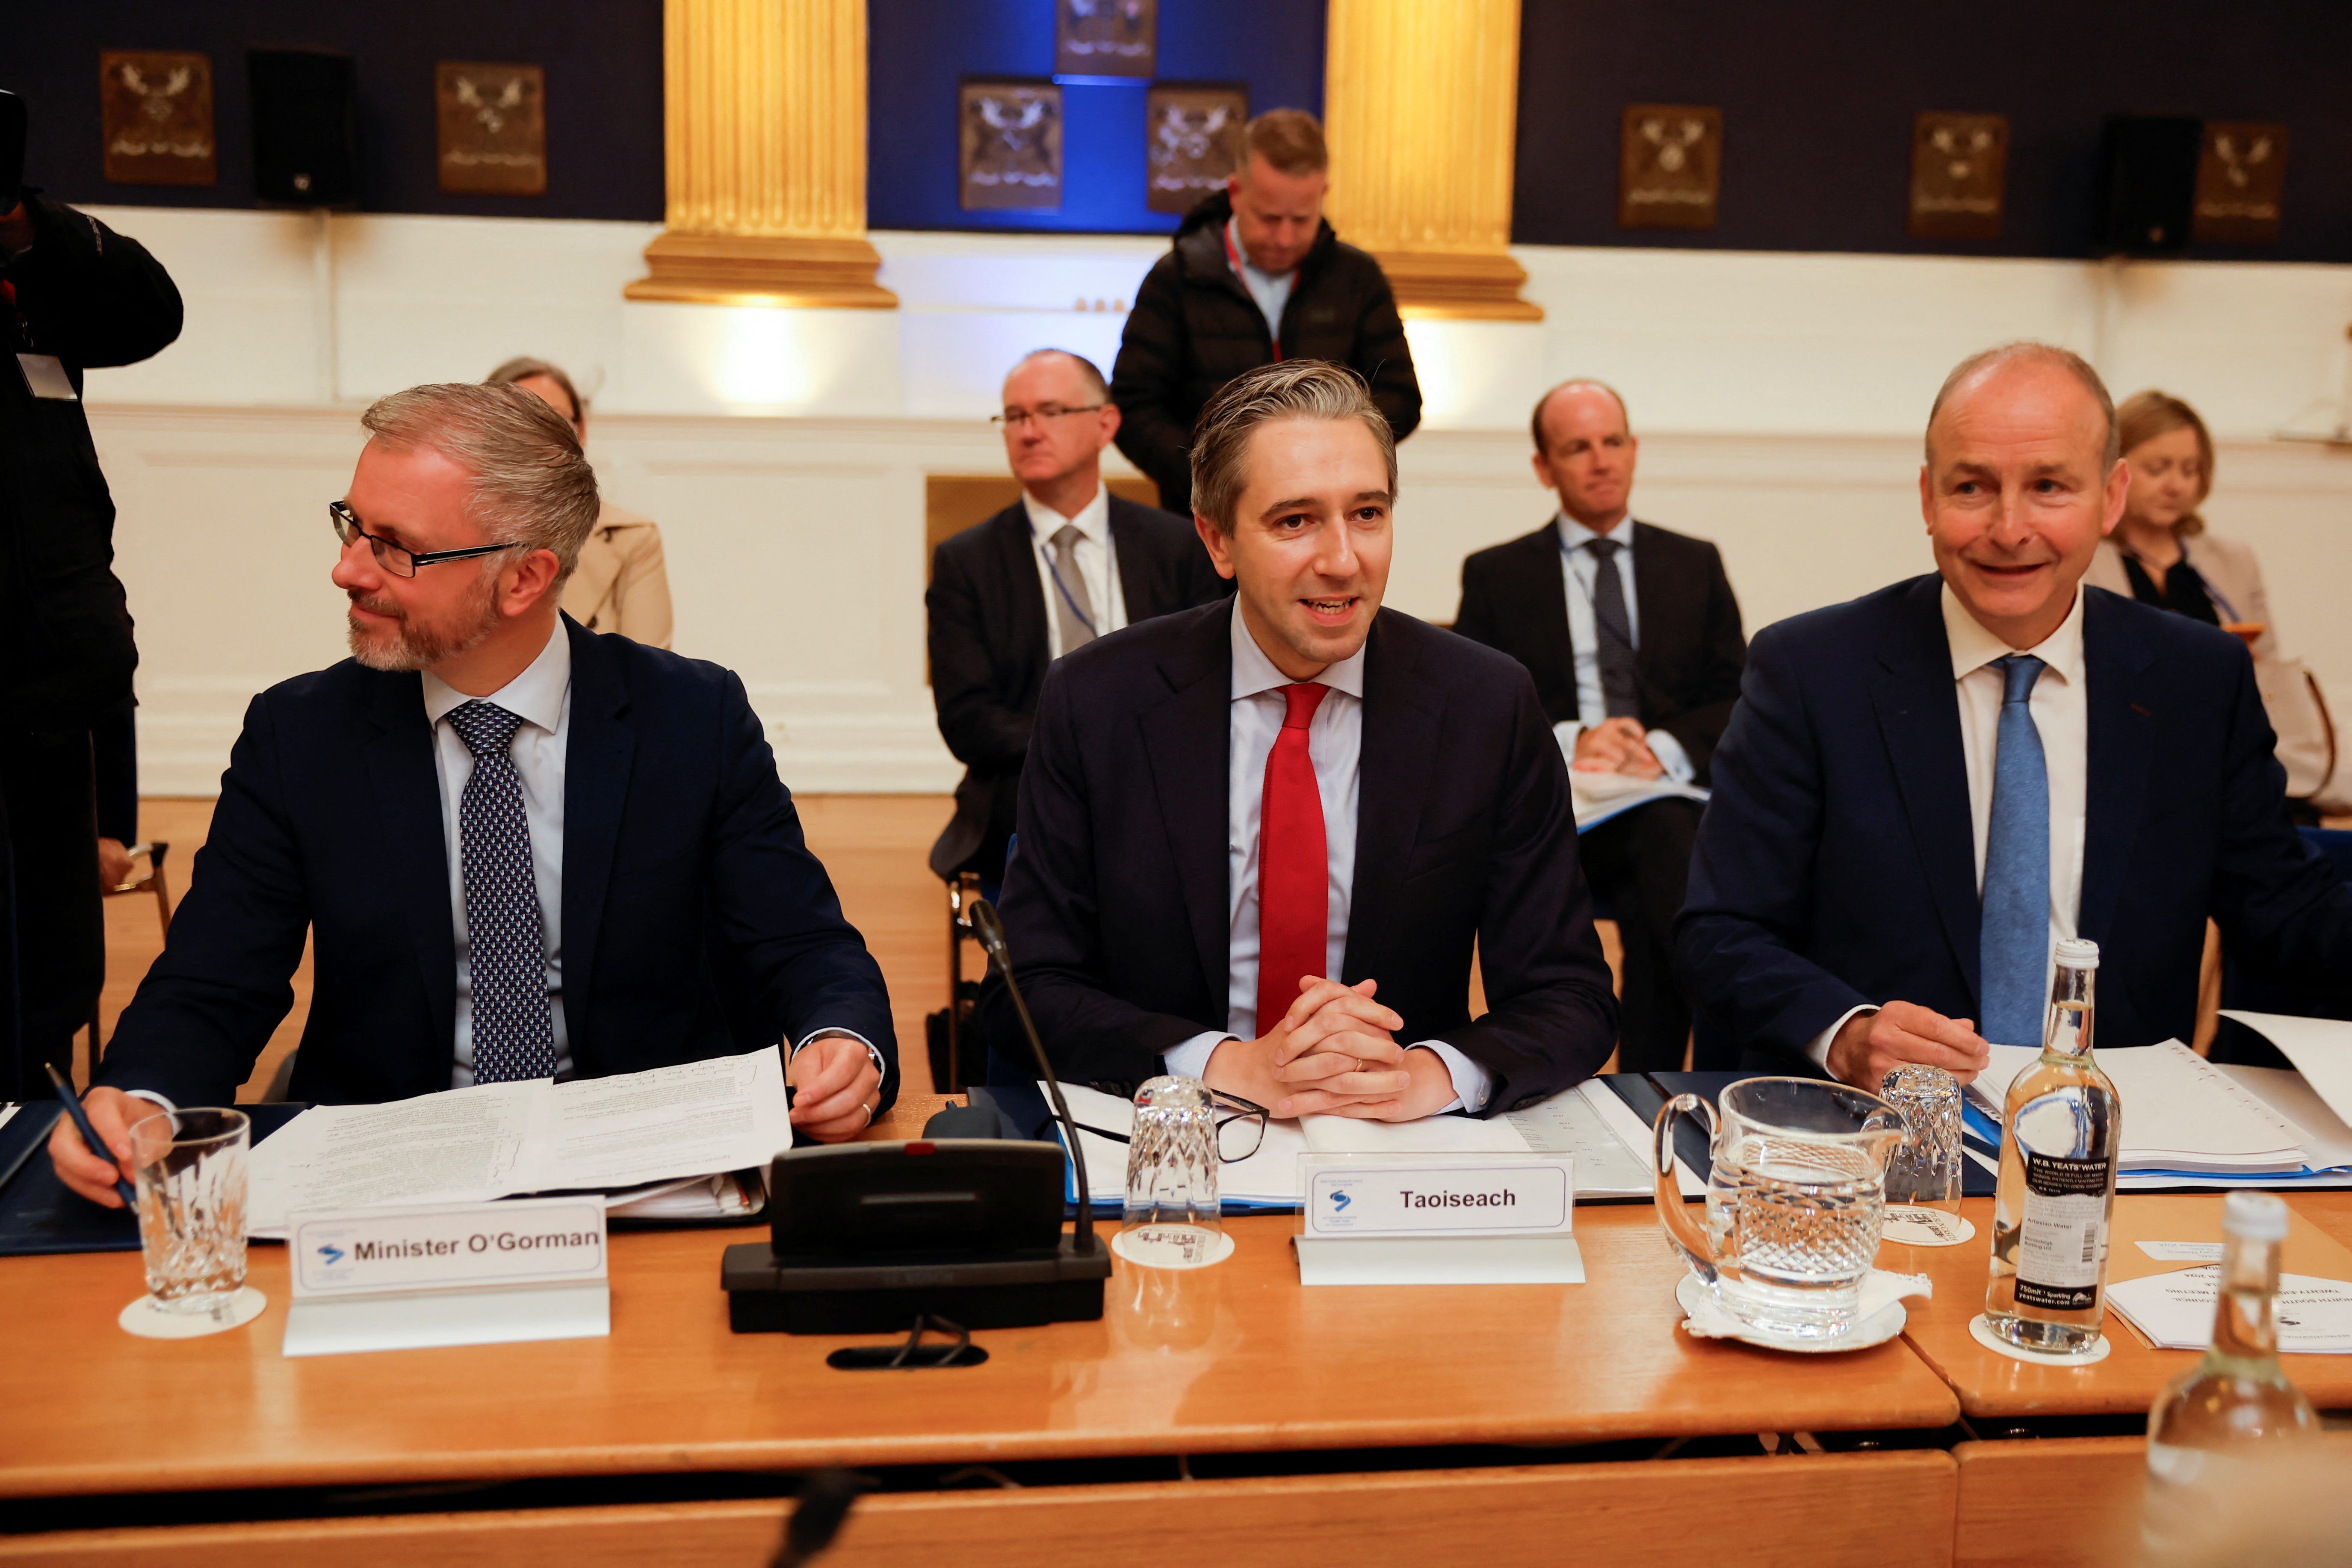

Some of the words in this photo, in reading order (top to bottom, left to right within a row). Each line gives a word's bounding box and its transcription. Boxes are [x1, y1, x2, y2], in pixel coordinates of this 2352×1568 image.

[2033, 1157, 2050, 1168] W.B.
[2081, 1162, 2107, 1172] WATER
[1400, 1189, 1516, 1208] Taoiseach
[2027, 1217, 2052, 1227] Artesian
[355, 1237, 458, 1261] Minister
[468, 1230, 599, 1253] O'Gorman
[2018, 1292, 2070, 1305] yeatswater.com
[2047, 1291, 2071, 1299] Sparkling
